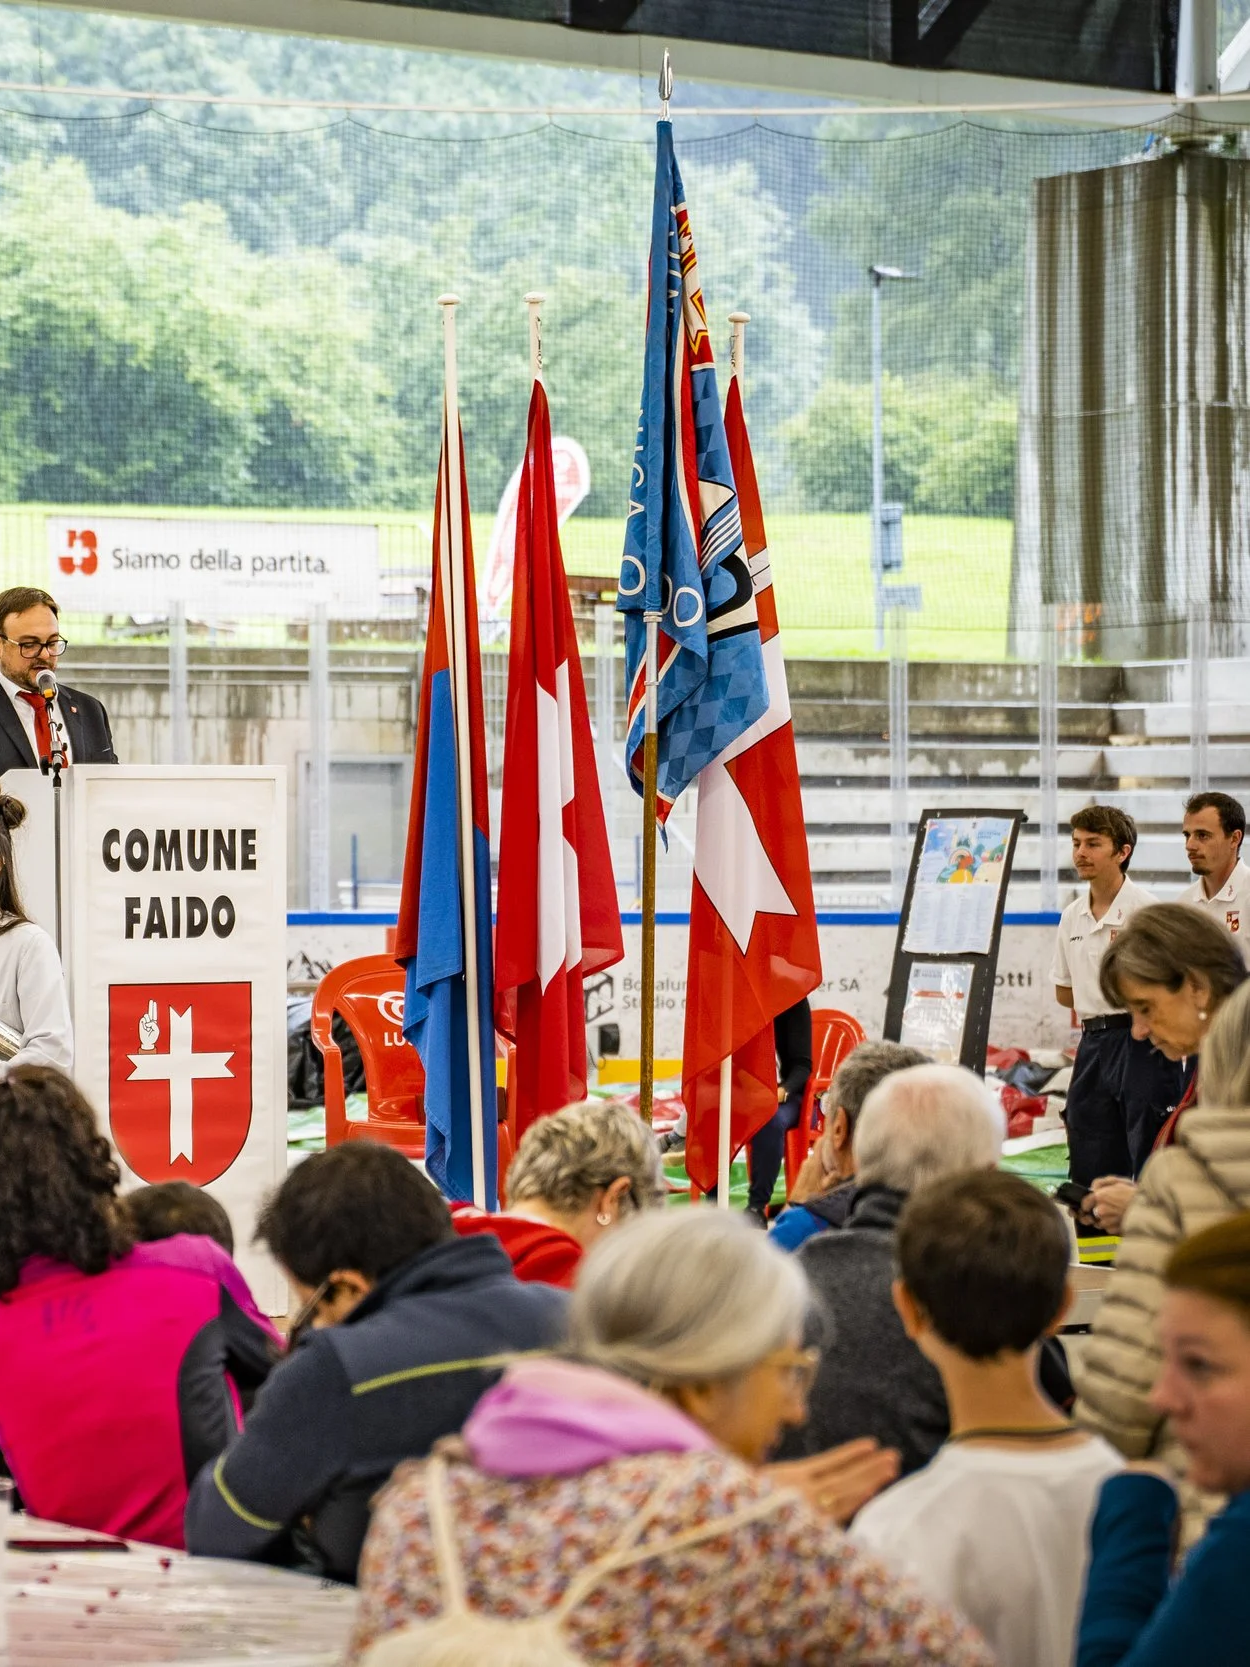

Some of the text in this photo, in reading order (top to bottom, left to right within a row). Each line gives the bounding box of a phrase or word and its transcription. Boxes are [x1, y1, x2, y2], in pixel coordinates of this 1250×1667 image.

[112, 548, 331, 577] Siamo della partita.
[102, 828, 257, 872] COMUNE
[124, 895, 236, 940] FAIDO
